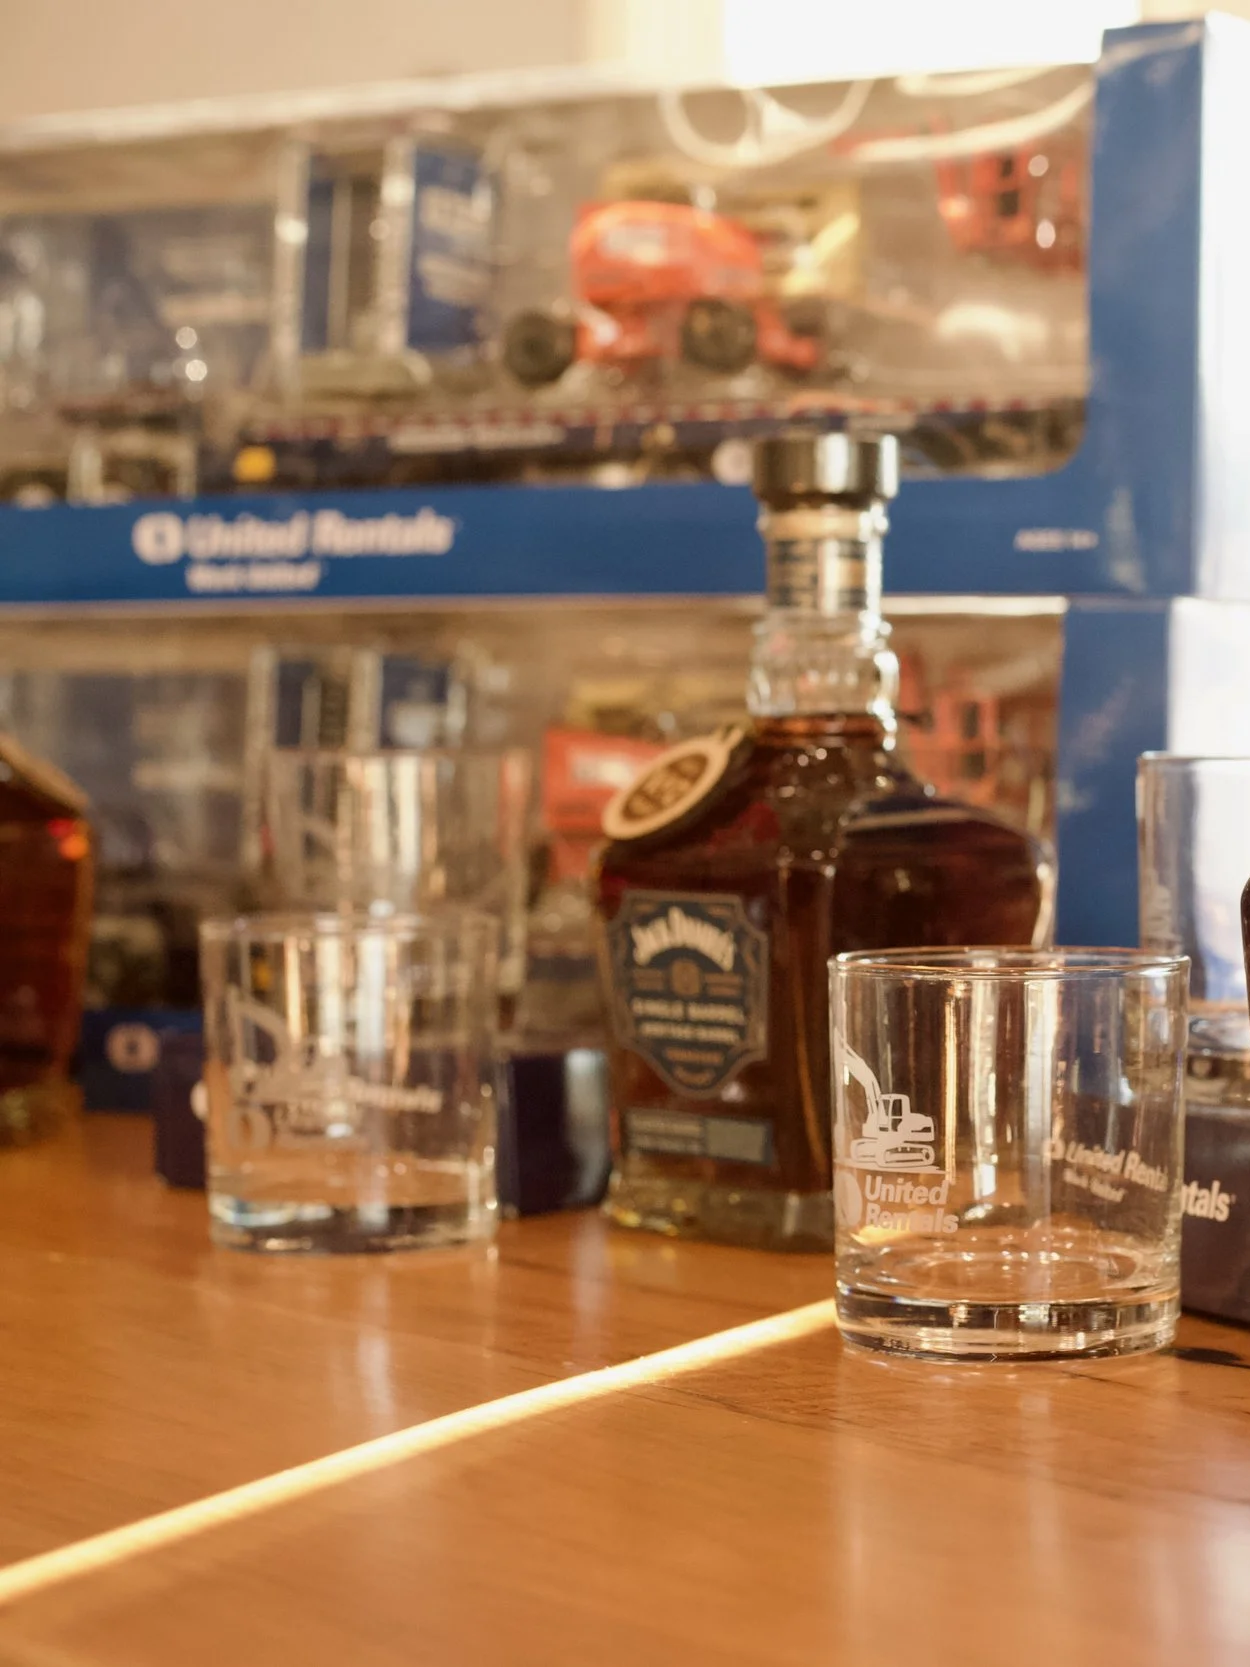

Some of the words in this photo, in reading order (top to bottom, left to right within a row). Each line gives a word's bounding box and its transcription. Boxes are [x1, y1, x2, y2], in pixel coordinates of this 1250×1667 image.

[1065, 1141, 1126, 1175] United
[865, 1174, 951, 1205] United
[866, 1202, 960, 1234] Rentals
